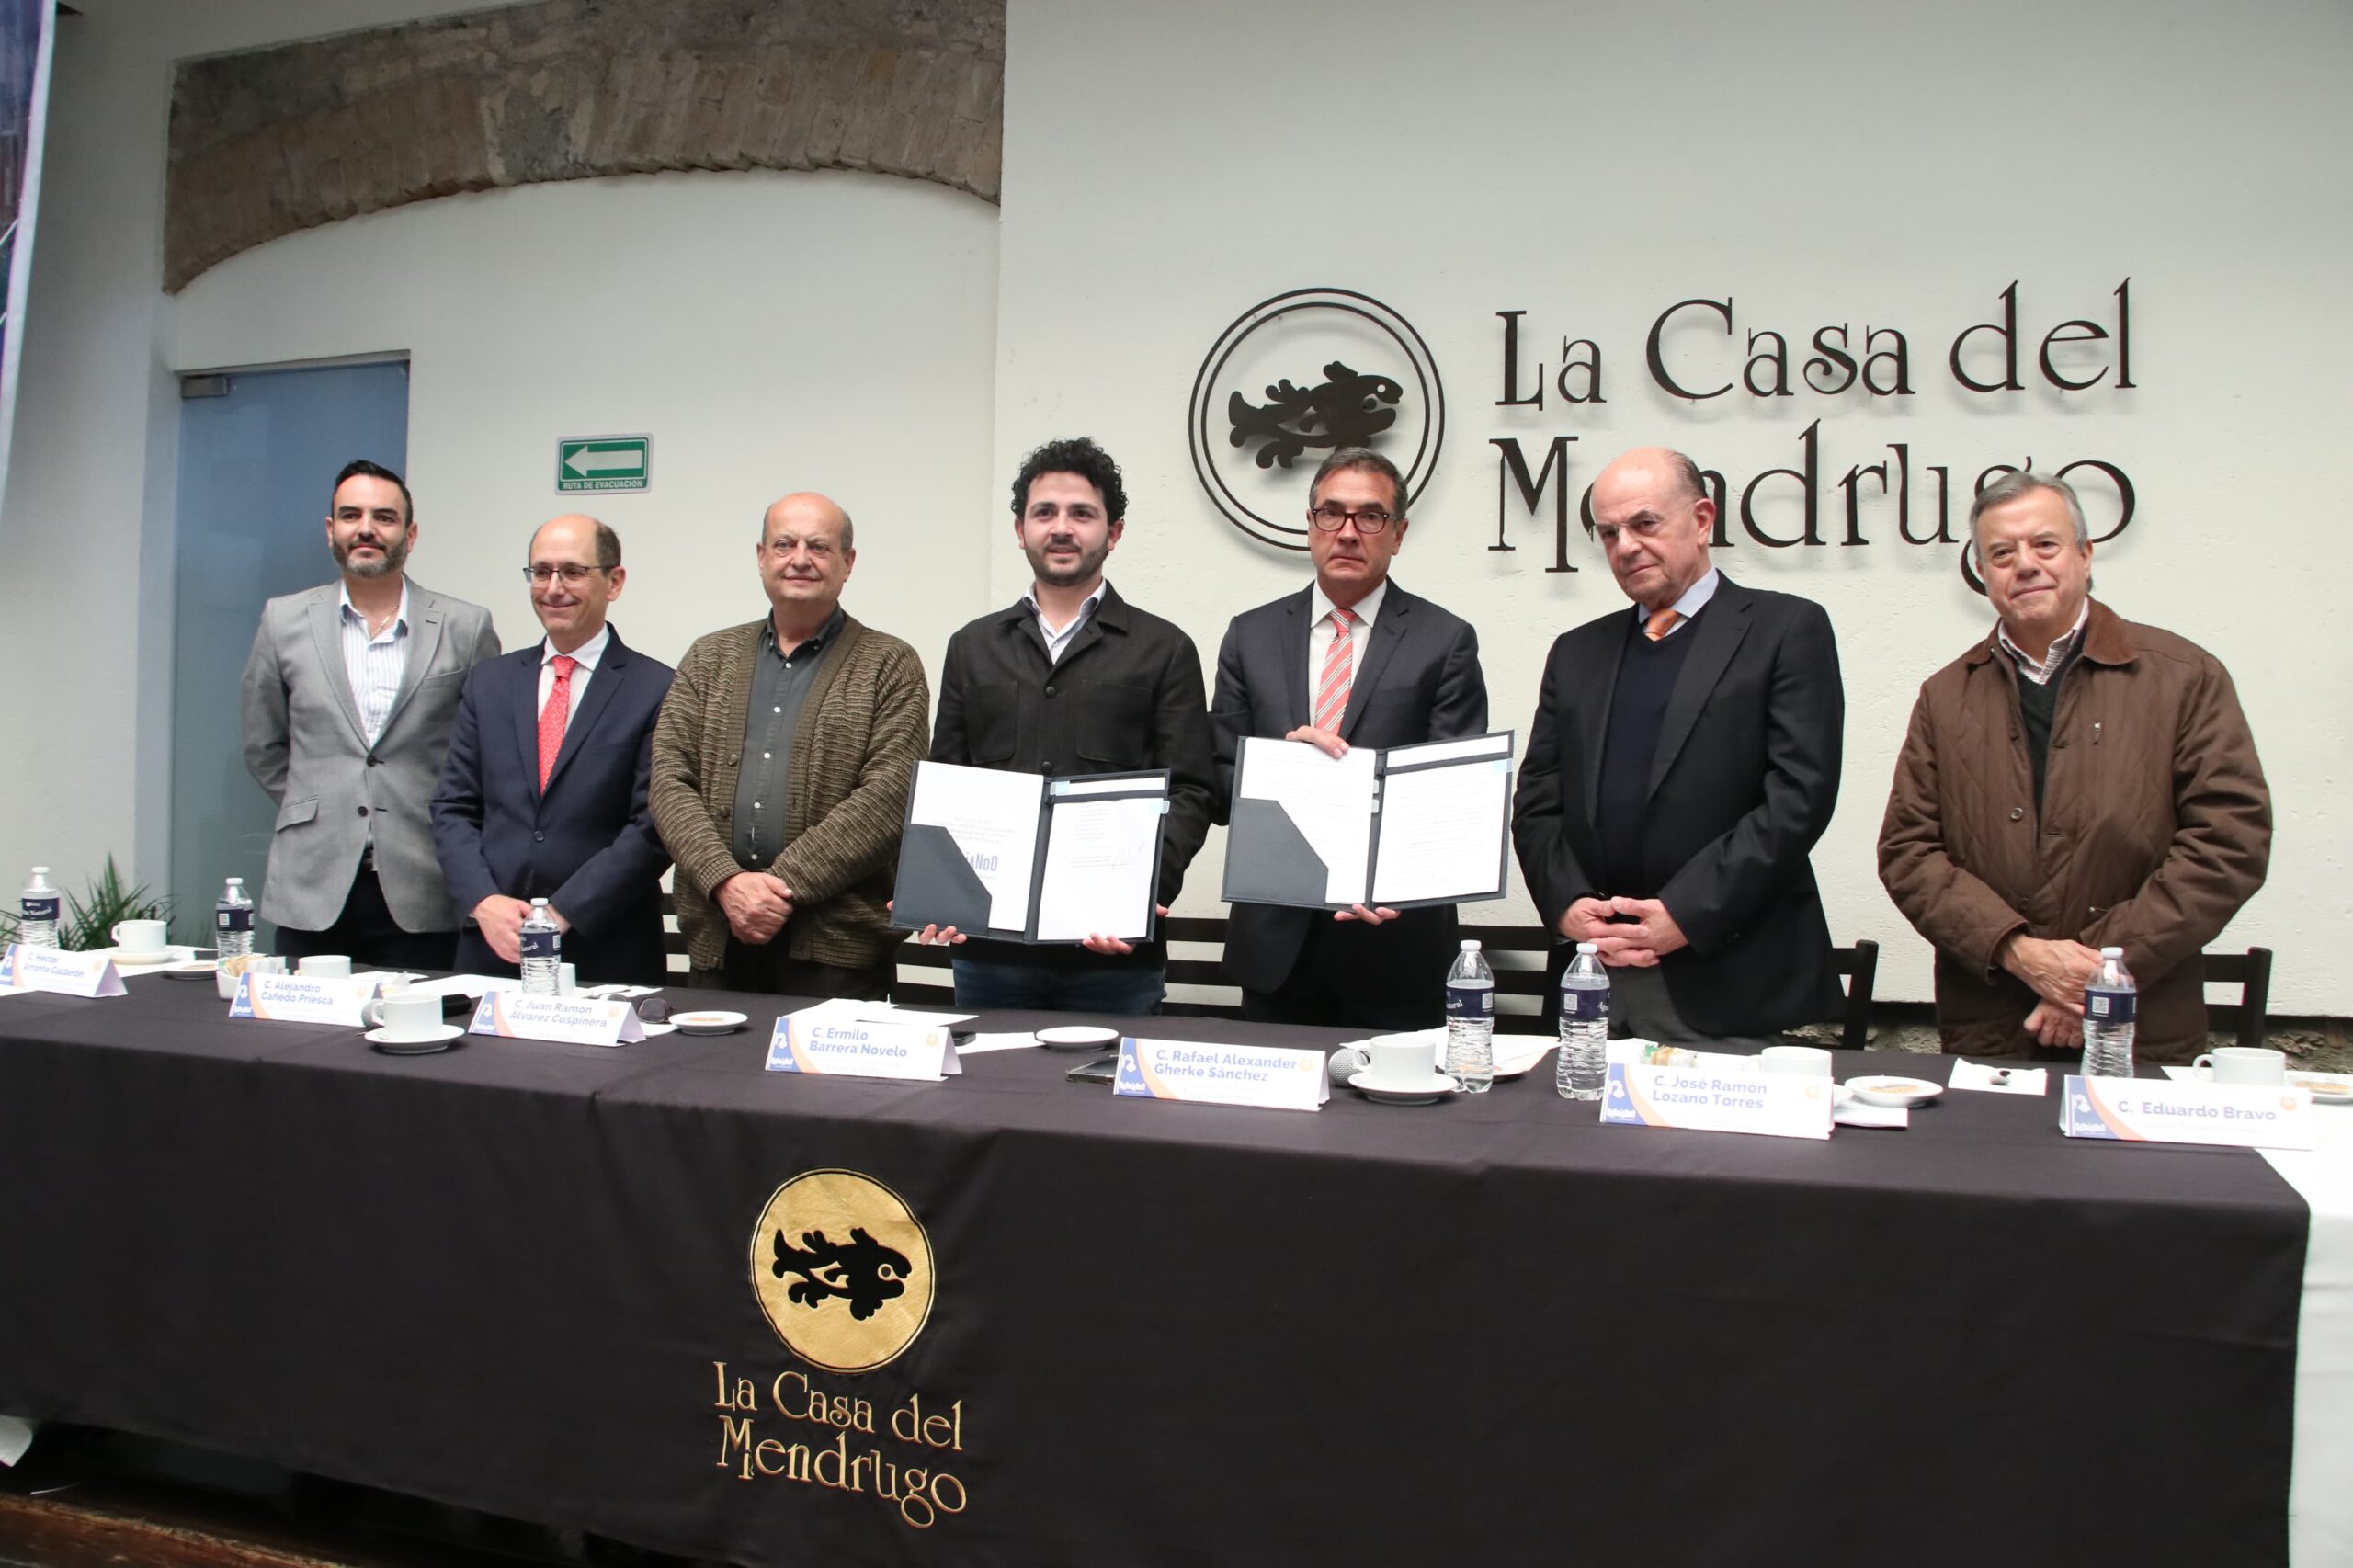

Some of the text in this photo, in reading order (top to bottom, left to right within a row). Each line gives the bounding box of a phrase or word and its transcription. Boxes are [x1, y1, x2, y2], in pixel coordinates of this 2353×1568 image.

[1495, 277, 2137, 412] La Casa del
[563, 481, 582, 490] RUTA
[584, 481, 594, 489] DE
[1487, 418, 2136, 597] Mndruo
[264, 980, 322, 994] C. Alejandro
[261, 991, 334, 1006] Cañedo Priesca
[514, 998, 593, 1015] C. Juan Ramón
[551, 1012, 608, 1028] Cuspinera
[812, 1027, 870, 1041] C. Ermilo
[809, 1040, 908, 1058] Barrera Novelo
[1155, 1049, 1298, 1070] C. Rafael Alexander
[1154, 1062, 1268, 1083] Gherke Sánchez
[1654, 1074, 1768, 1095] C. José Ramón
[1652, 1089, 1765, 1109] Lozano Torres
[2118, 1100, 2277, 1121] C. Eduardo Bravo
[712, 1361, 963, 1451] La Casa del
[716, 1415, 967, 1528] Mendrugo
